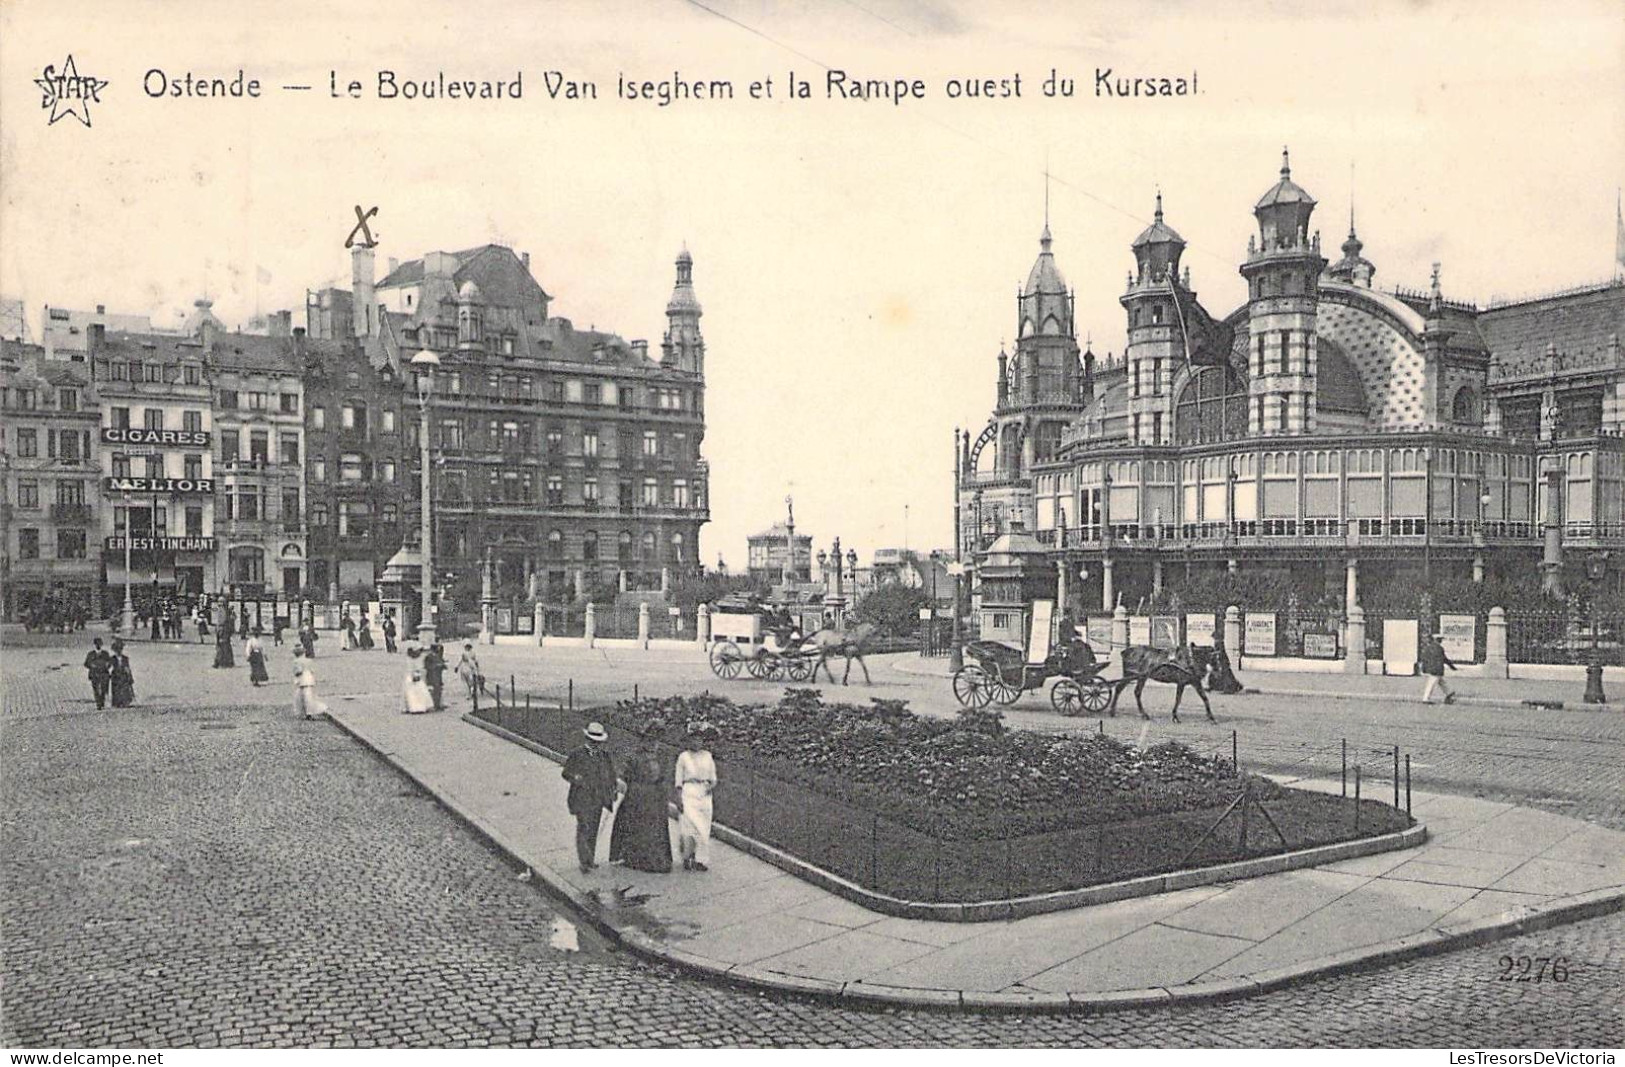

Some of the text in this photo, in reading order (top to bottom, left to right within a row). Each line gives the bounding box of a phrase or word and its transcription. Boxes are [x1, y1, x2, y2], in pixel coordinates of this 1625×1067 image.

[42, 64, 100, 108] STAR
[143, 68, 261, 98] Ostende
[330, 70, 362, 99] Le
[378, 70, 522, 100] Boulevard
[543, 71, 597, 100] Van
[618, 71, 733, 107] Iseghem
[749, 78, 773, 99] et
[789, 71, 811, 99] la
[826, 70, 926, 106] Rampe
[946, 73, 1022, 99] ouest
[1042, 68, 1074, 98] du
[105, 429, 207, 445] CIGARES
[110, 478, 212, 491] MELIOR
[160, 538, 214, 550] TINCHANT
[1499, 955, 1569, 983] 2276
